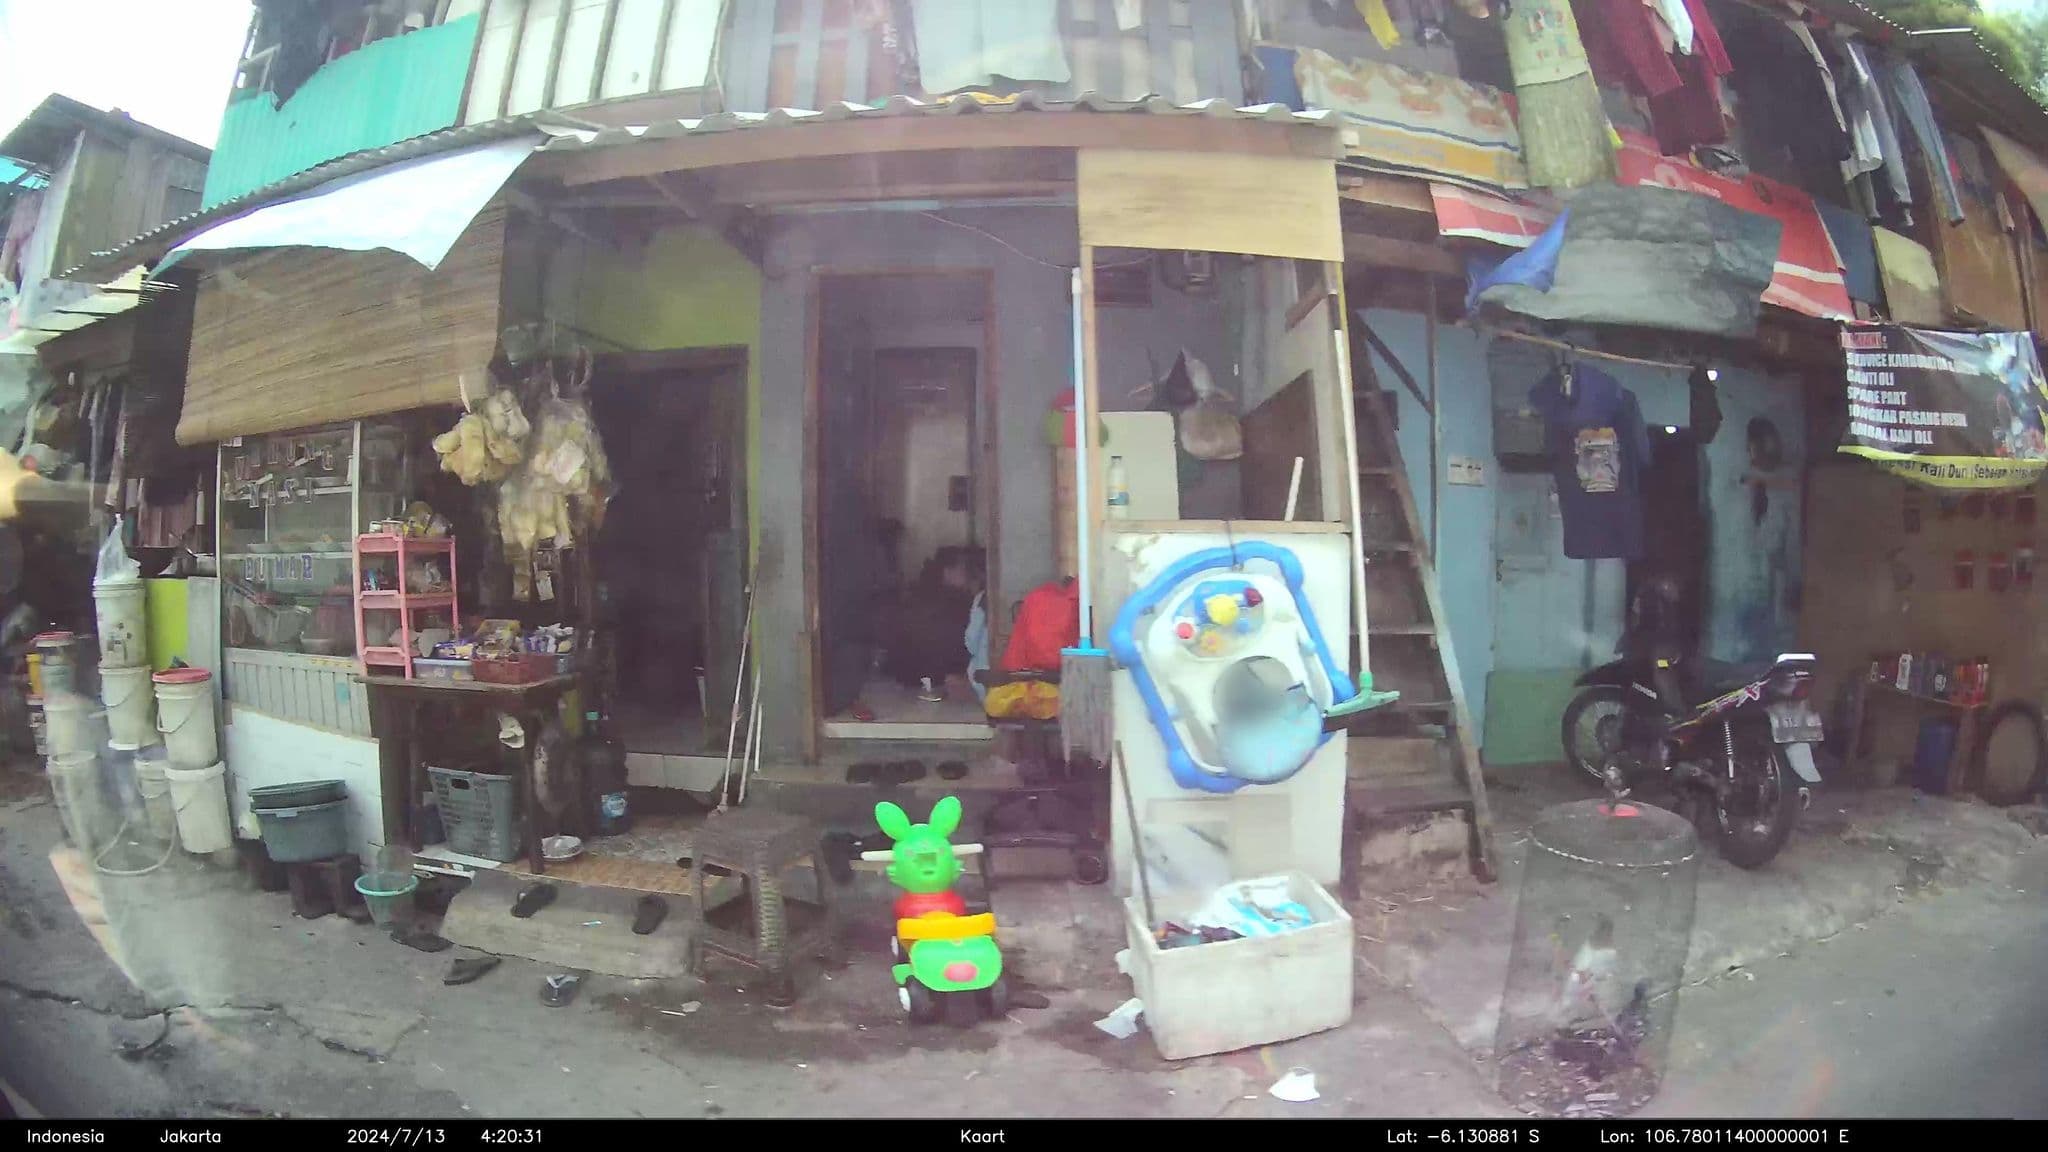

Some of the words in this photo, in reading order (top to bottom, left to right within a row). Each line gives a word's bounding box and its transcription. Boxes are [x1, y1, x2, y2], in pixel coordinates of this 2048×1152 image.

[1879, 372, 1895, 386] OLI
[1847, 386, 1881, 404] SPARE
[1882, 391, 1907, 406] PART
